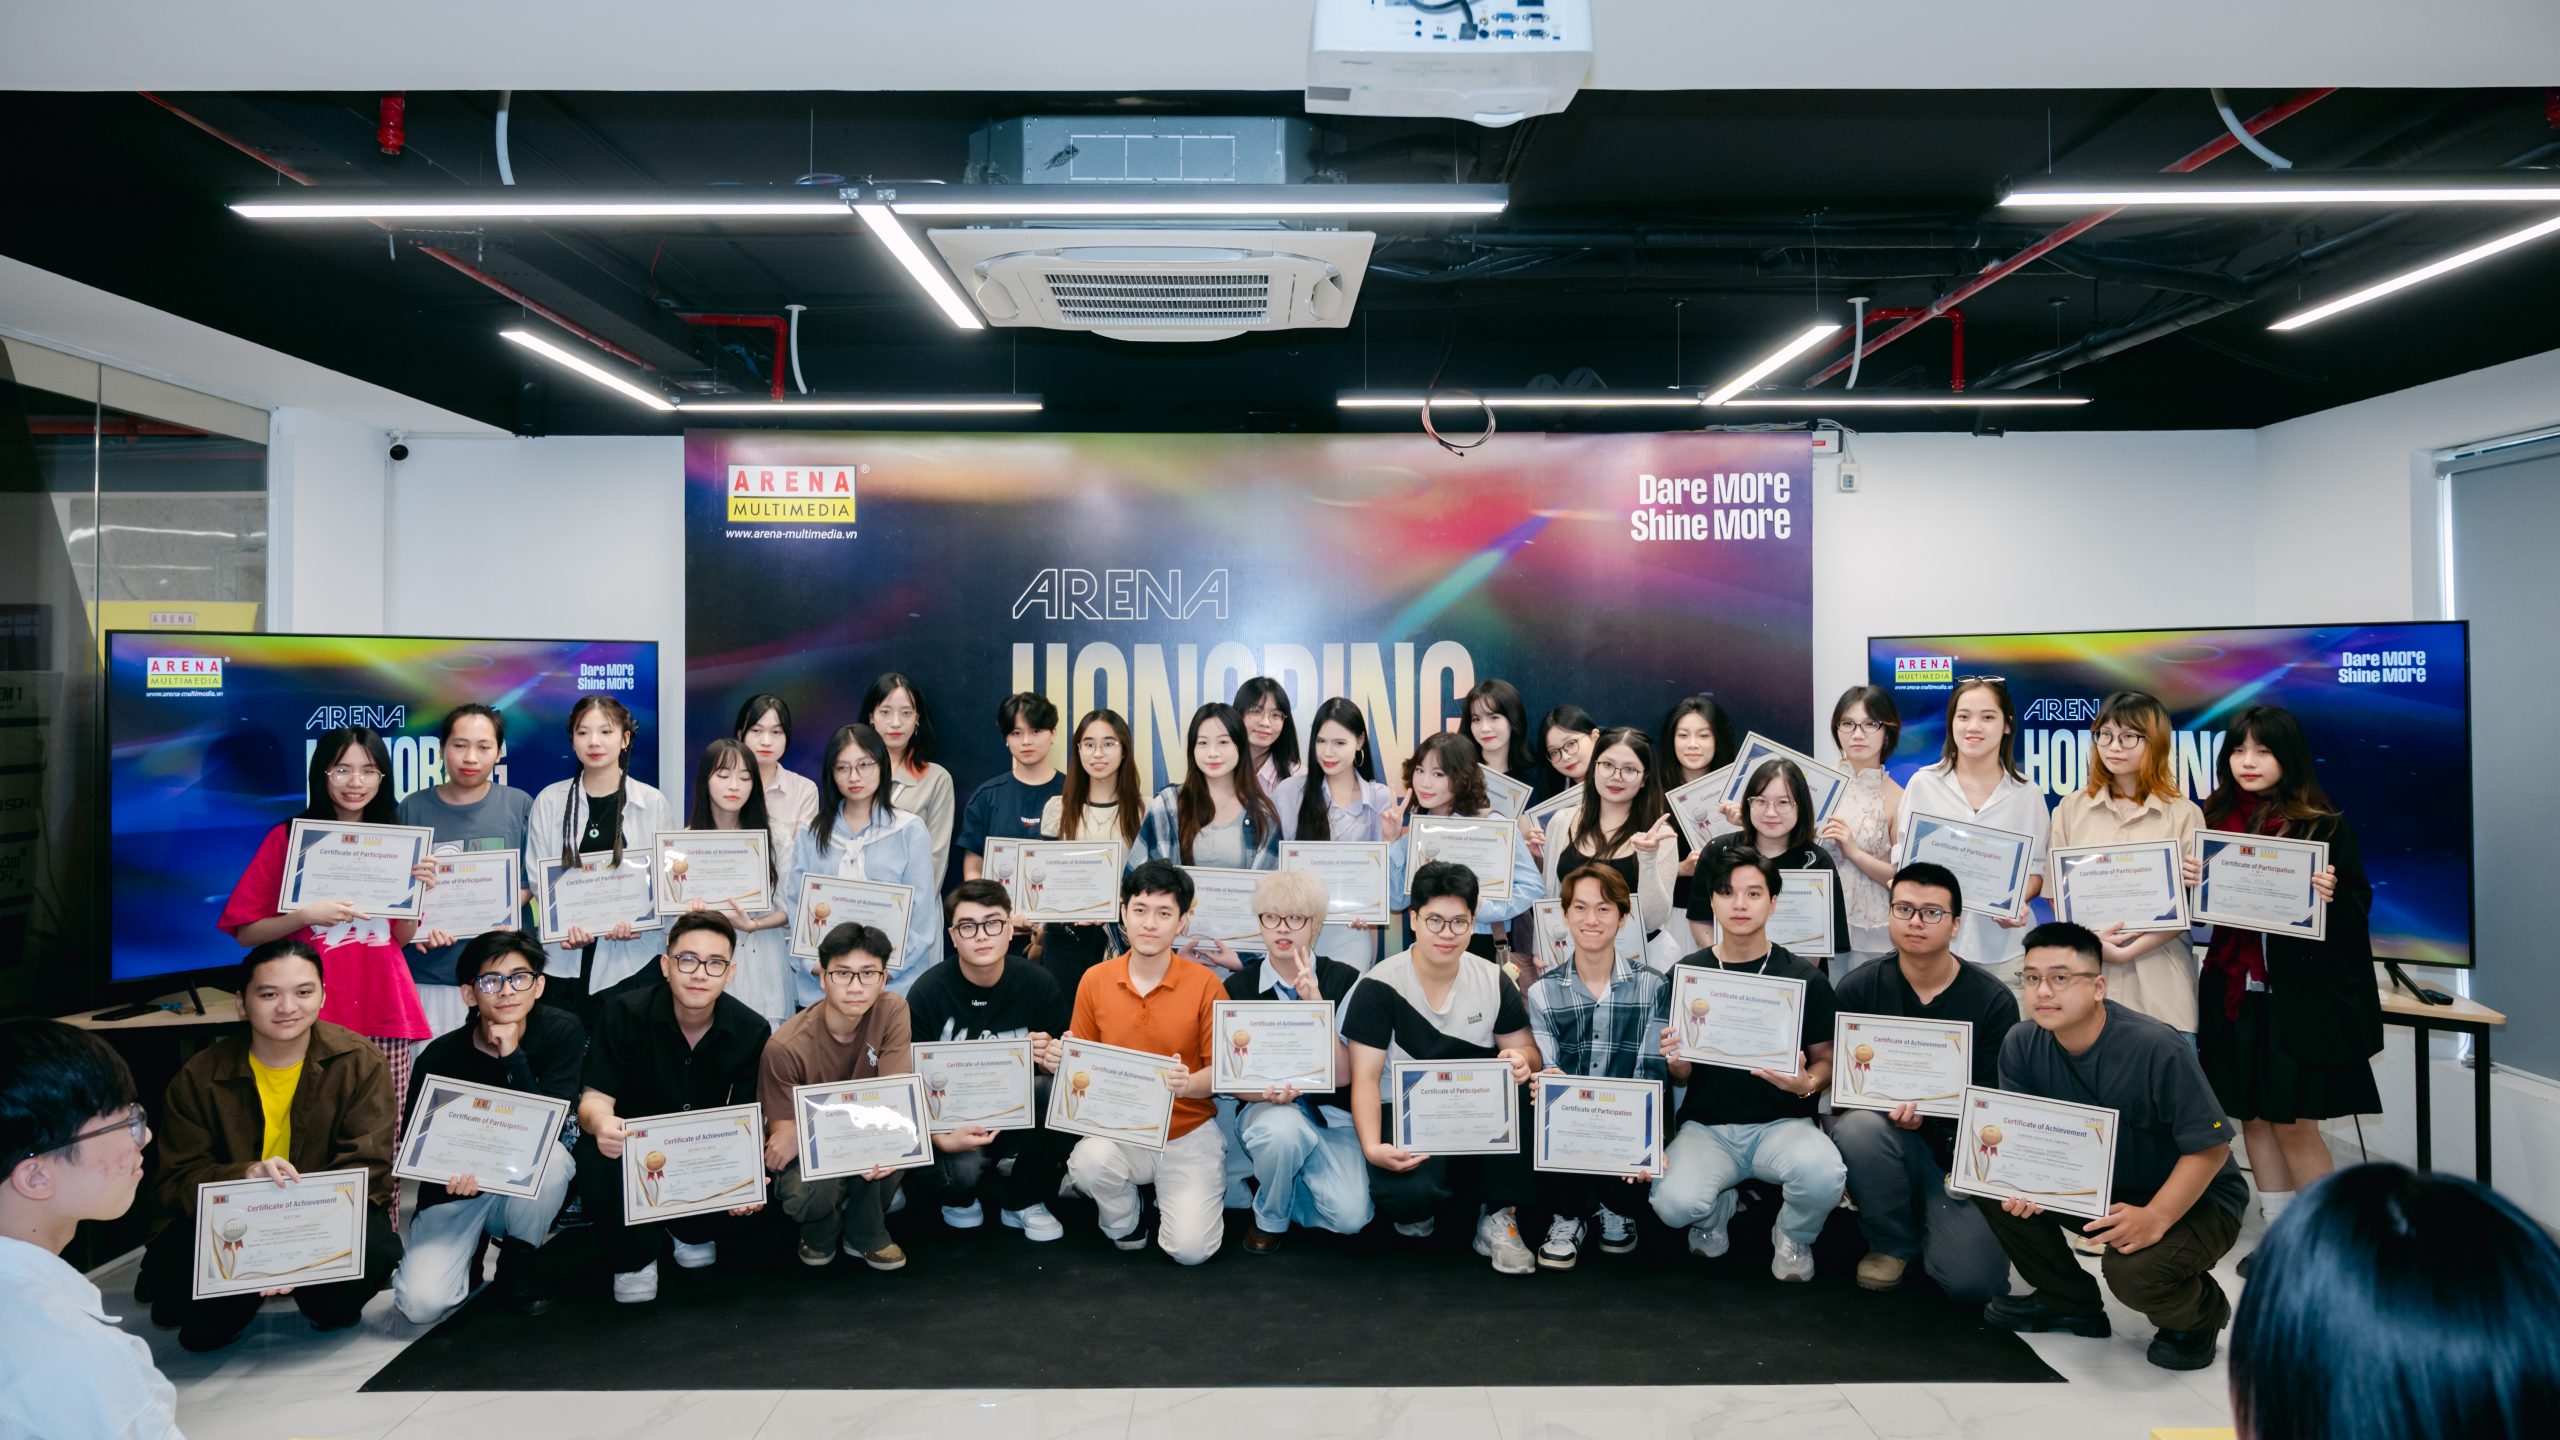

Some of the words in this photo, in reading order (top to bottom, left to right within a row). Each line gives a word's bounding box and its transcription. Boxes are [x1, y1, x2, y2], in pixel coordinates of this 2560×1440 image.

[734, 470, 850, 493] ARENA
[1639, 474, 1708, 505] Dare
[733, 503, 850, 517] MULTIMEDIA
[1630, 509, 1708, 541] Shine
[726, 529, 858, 539] www.arena-multimedia.vn
[1012, 568, 1229, 620] ARENA
[153, 614, 193, 624] ARENA
[151, 660, 219, 672] ARENA
[1898, 659, 1950, 669] ARENA
[2342, 652, 2380, 667] Dare
[580, 663, 606, 677] Dare
[2338, 667, 2380, 683] Shine
[150, 677, 219, 685] MULTIMEDIA
[577, 677, 606, 690] Shine
[2023, 698, 2100, 721] AREN
[306, 705, 405, 730] ARENA
[1931, 840, 1960, 852] Certificate
[320, 848, 352, 857] Certificate
[360, 851, 399, 860] Participation
[2116, 867, 2152, 875] Participation
[2221, 859, 2251, 869] Certificate
[2258, 864, 2296, 874] Participation
[1874, 1036, 1903, 1045] Certificate
[1910, 1040, 1948, 1049] Achievement
[1420, 1087, 1449, 1095] Certificate
[1456, 1087, 1491, 1095] Participation
[1561, 1104, 1590, 1113] Certificate
[1597, 1107, 1633, 1117] Participation
[448, 1111, 481, 1123] Certificate
[489, 1118, 529, 1132] Participation
[2003, 1117, 2037, 1129] Certificate
[2037, 1122, 2045, 1130] of
[2045, 1124, 2088, 1138] Achievement
[664, 1136, 694, 1146] Certificate
[701, 1129, 739, 1140] Achievement
[247, 1202, 284, 1213] Certificate
[285, 1200, 292, 1208] of
[293, 1196, 338, 1208] Achievement
